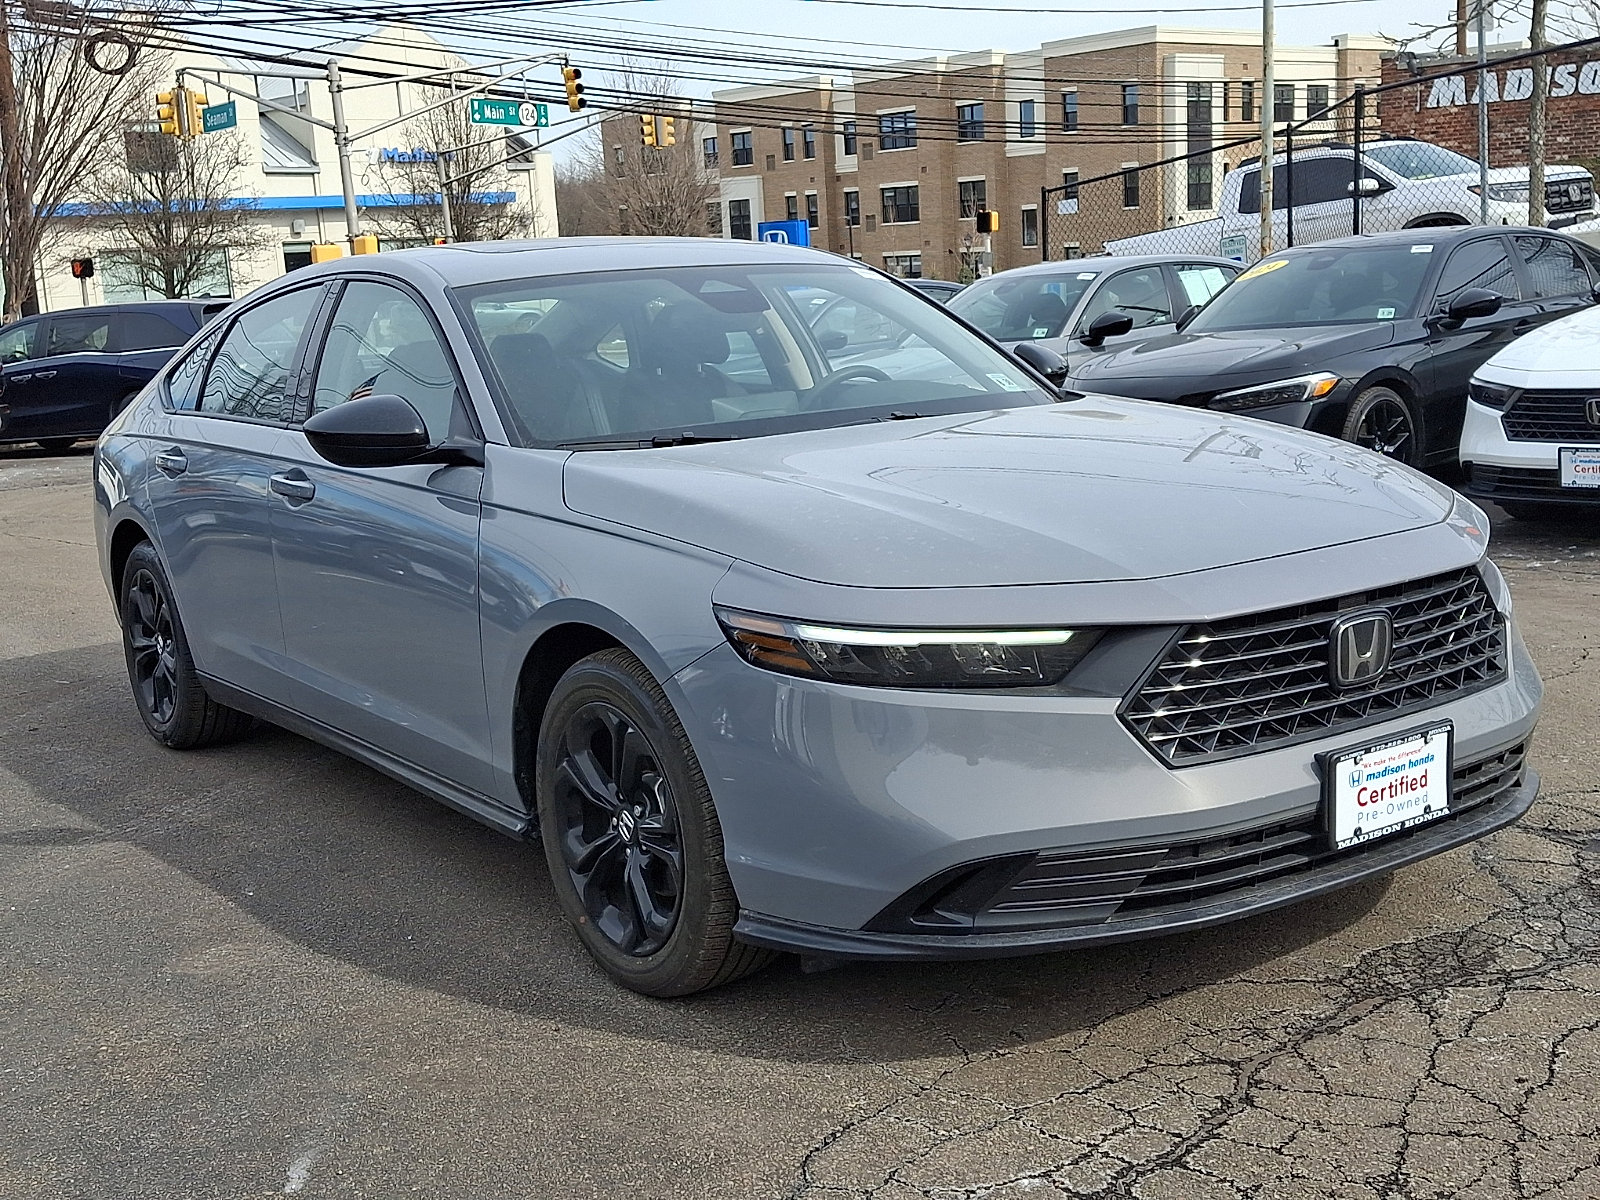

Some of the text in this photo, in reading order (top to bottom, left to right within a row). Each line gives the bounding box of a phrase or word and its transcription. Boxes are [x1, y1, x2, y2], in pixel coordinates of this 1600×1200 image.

[483, 104, 505, 119] Main
[521, 108, 536, 121] 124
[1365, 763, 1406, 782] madison
[1408, 752, 1435, 769] honda
[1357, 768, 1428, 807] Certified
[1357, 791, 1428, 824] Pre-Owned
[1337, 806, 1451, 850] MADISON HONDA
